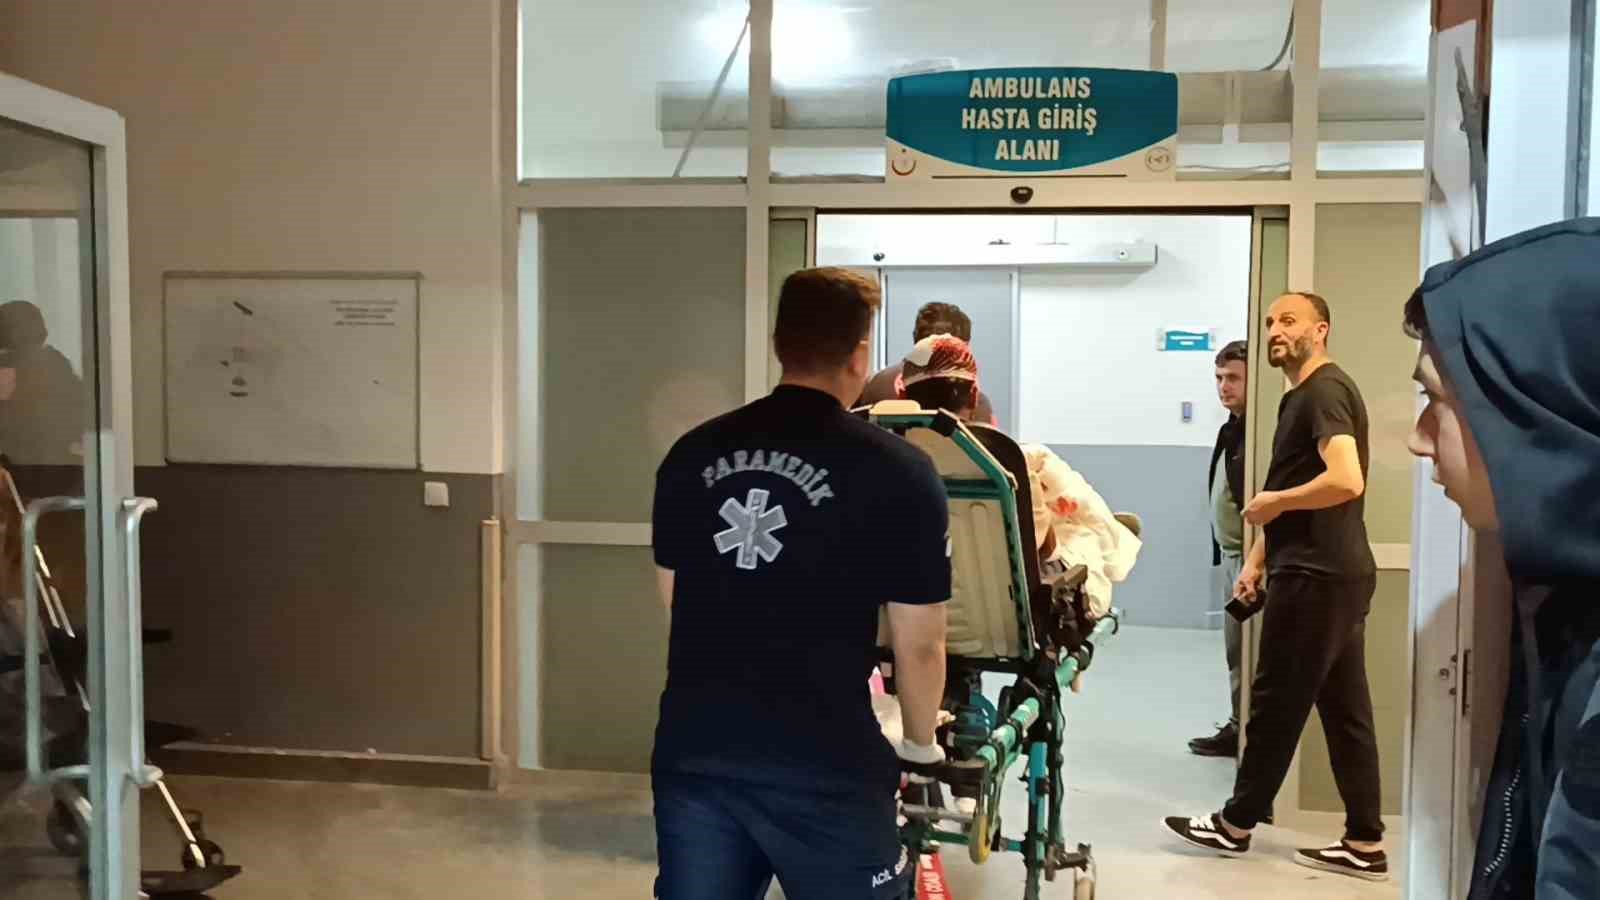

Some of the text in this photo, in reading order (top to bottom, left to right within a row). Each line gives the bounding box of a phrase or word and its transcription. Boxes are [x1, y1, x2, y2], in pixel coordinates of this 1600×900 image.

[969, 77, 1091, 98] AMBULANS
[961, 103, 1097, 136] HASTA GİRİŞ
[995, 139, 1060, 160] ALANI
[701, 449, 835, 506] PARAMEDİK
